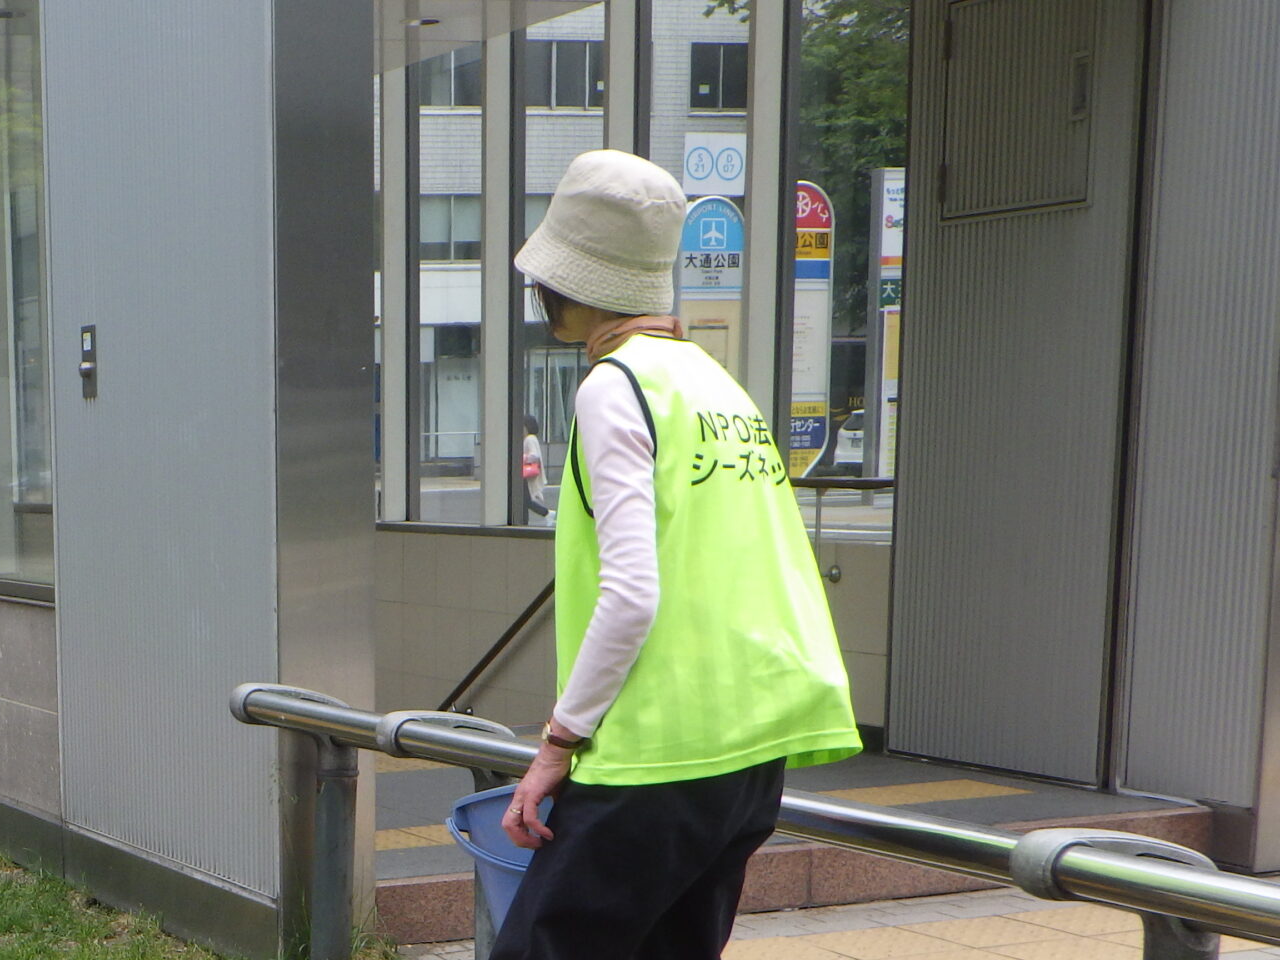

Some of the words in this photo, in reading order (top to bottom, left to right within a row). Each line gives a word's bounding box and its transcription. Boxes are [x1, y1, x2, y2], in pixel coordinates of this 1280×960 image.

[694, 163, 705, 173] 21
[723, 163, 735, 173] 07
[796, 232, 828, 249] 公園
[684, 252, 740, 269] 大通公園
